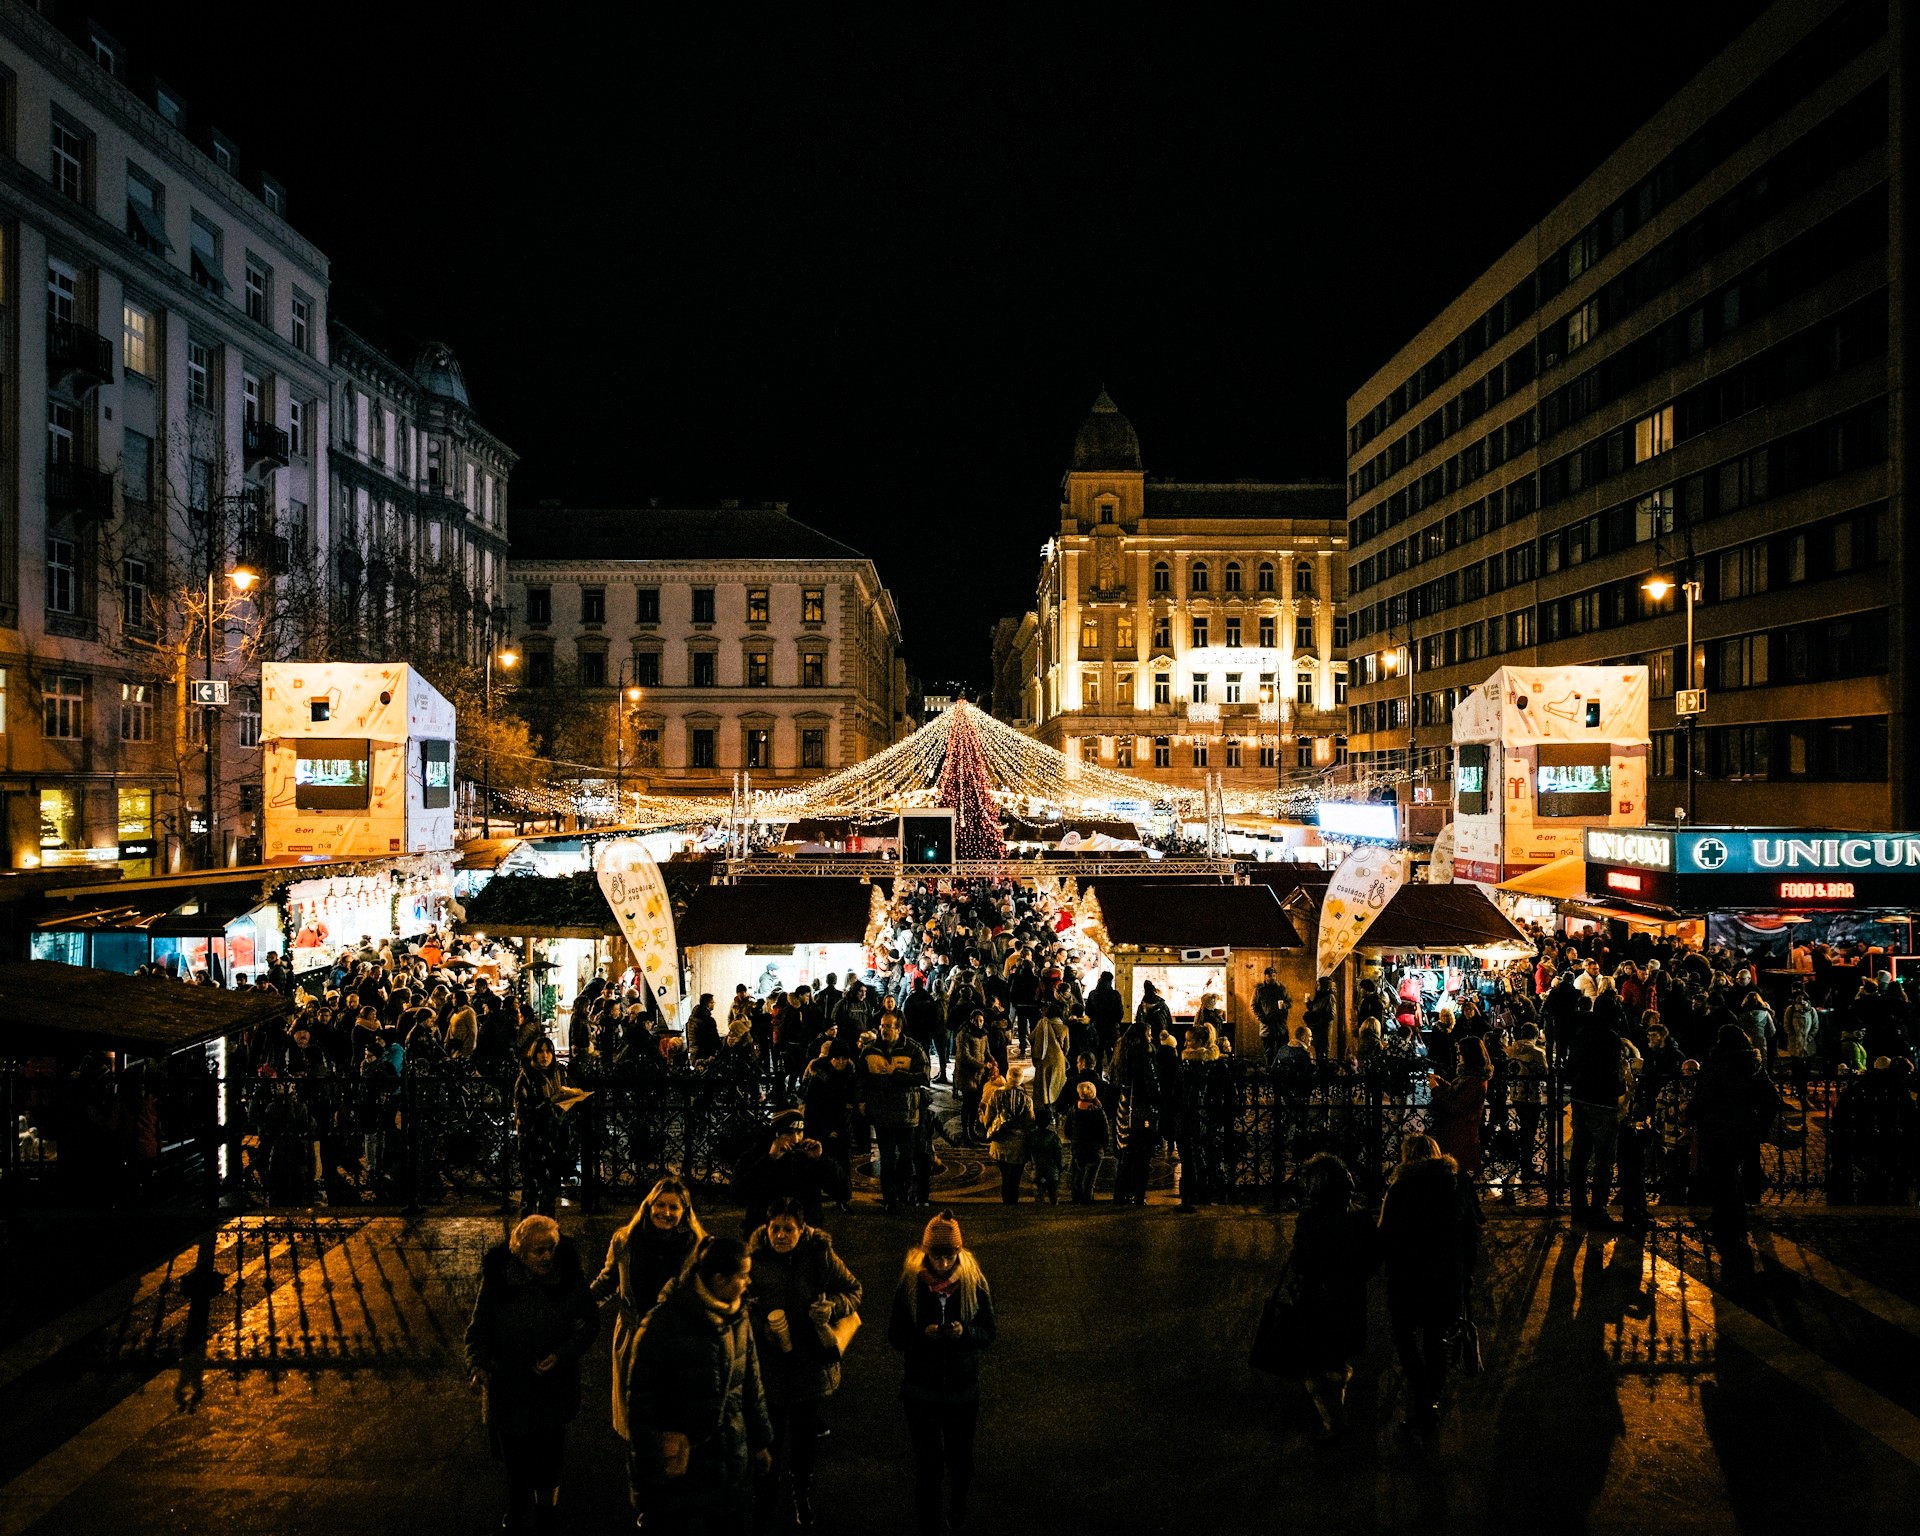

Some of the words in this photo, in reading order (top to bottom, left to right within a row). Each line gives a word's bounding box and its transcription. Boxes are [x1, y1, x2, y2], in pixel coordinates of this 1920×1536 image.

[1587, 832, 1669, 866] UNICUM
[1781, 883, 1814, 898] FOOD
[1827, 883, 1854, 898] BAR
[789, 1120, 805, 1130] 46
